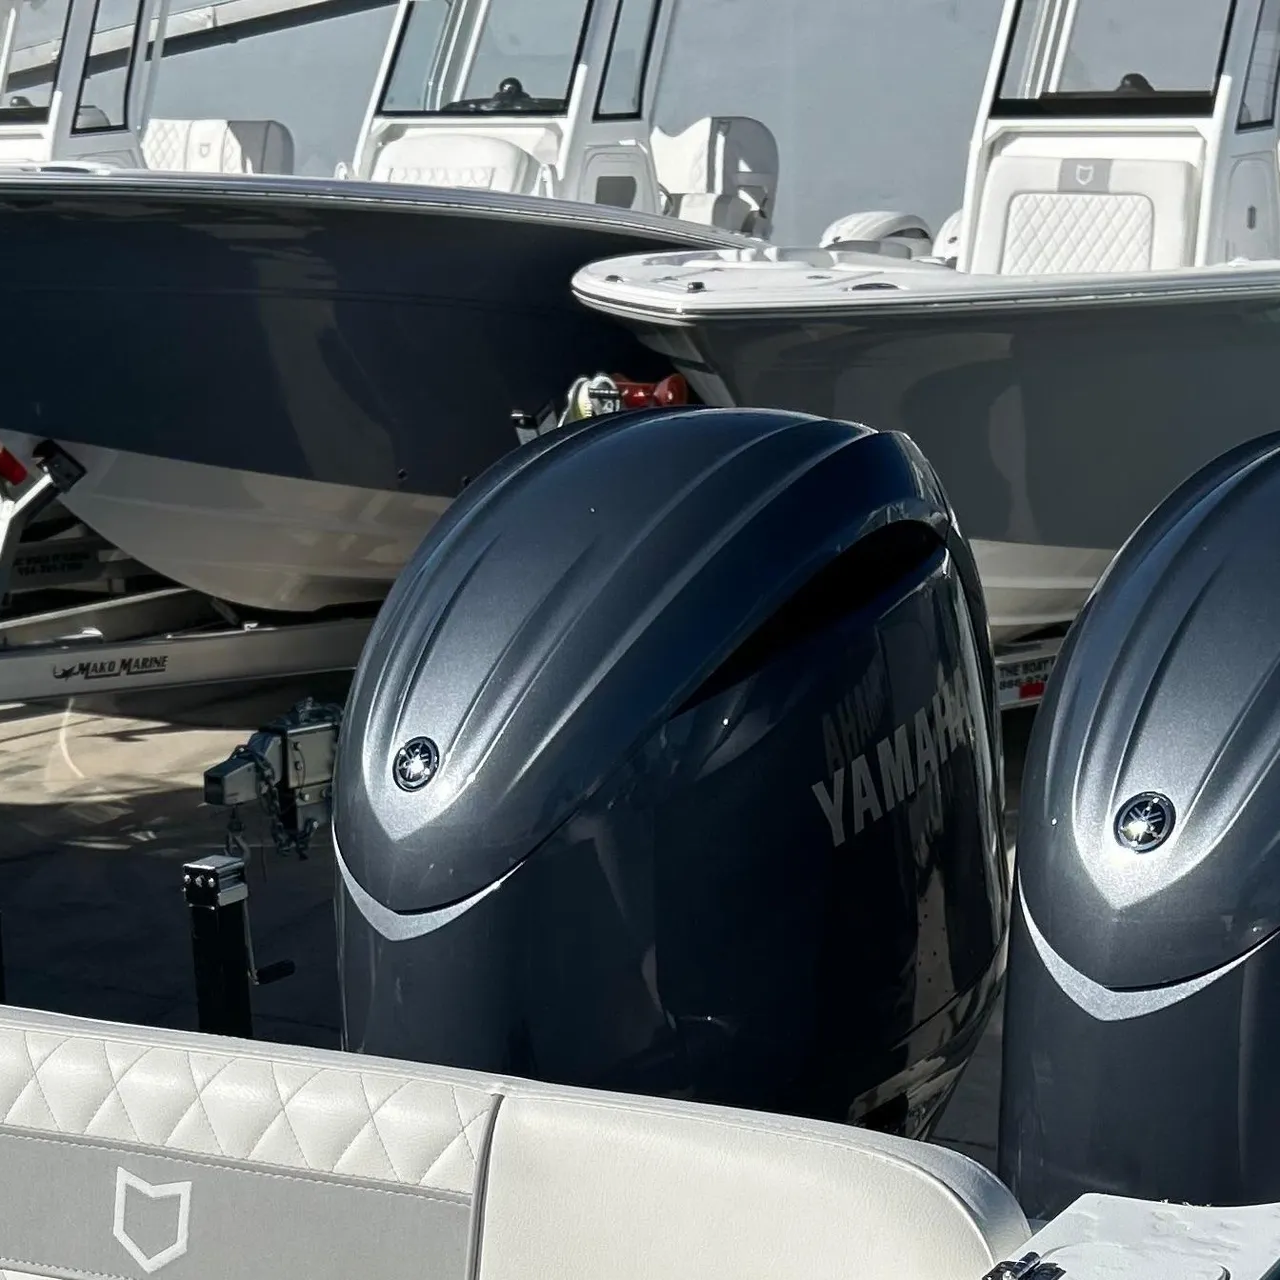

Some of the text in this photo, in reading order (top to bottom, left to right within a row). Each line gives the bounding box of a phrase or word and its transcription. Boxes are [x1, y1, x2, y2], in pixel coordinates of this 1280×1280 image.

[77, 656, 168, 679] MAKO MARINE
[811, 668, 974, 847] YAMAHA
